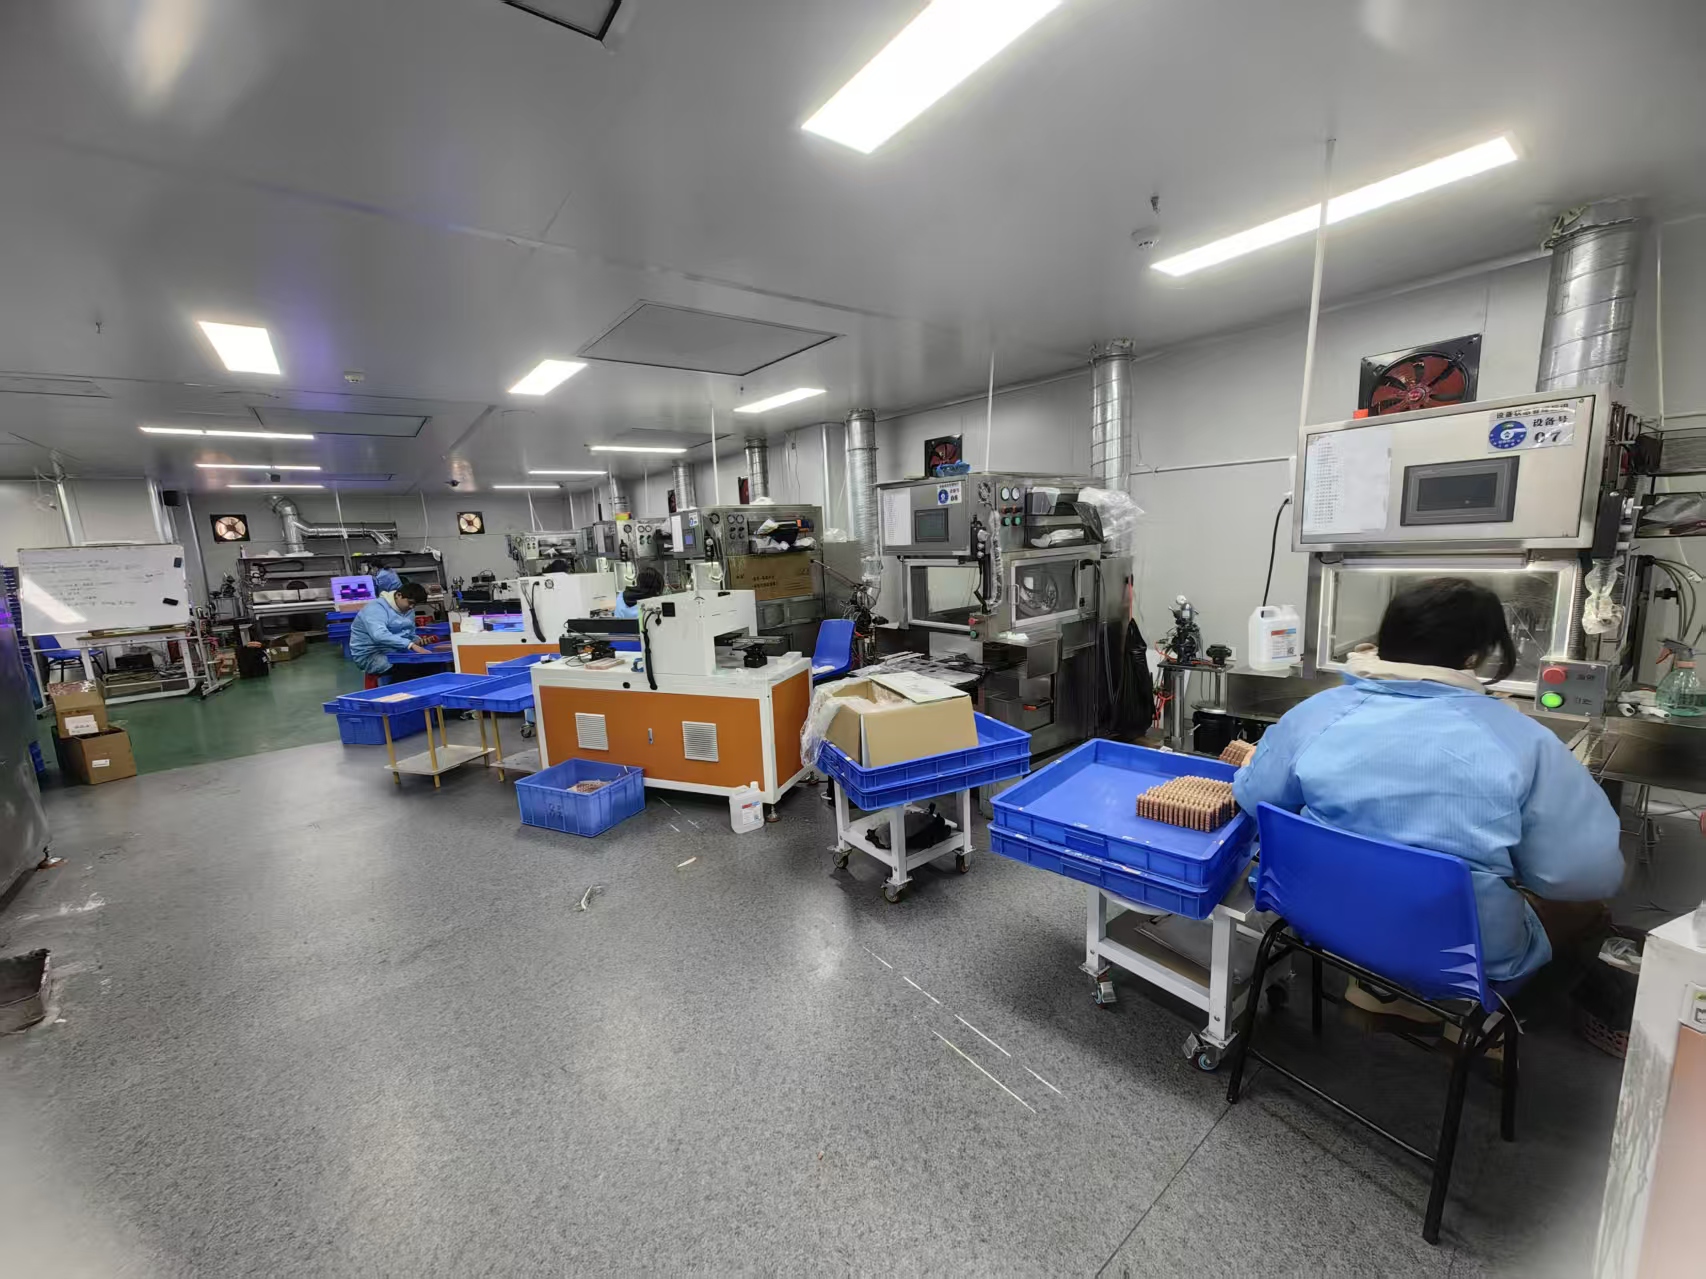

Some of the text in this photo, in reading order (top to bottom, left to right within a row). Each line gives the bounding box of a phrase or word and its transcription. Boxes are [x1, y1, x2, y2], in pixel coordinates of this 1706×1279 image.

[1533, 415, 1568, 427] 设备号
[1534, 430, 1562, 443] 07
